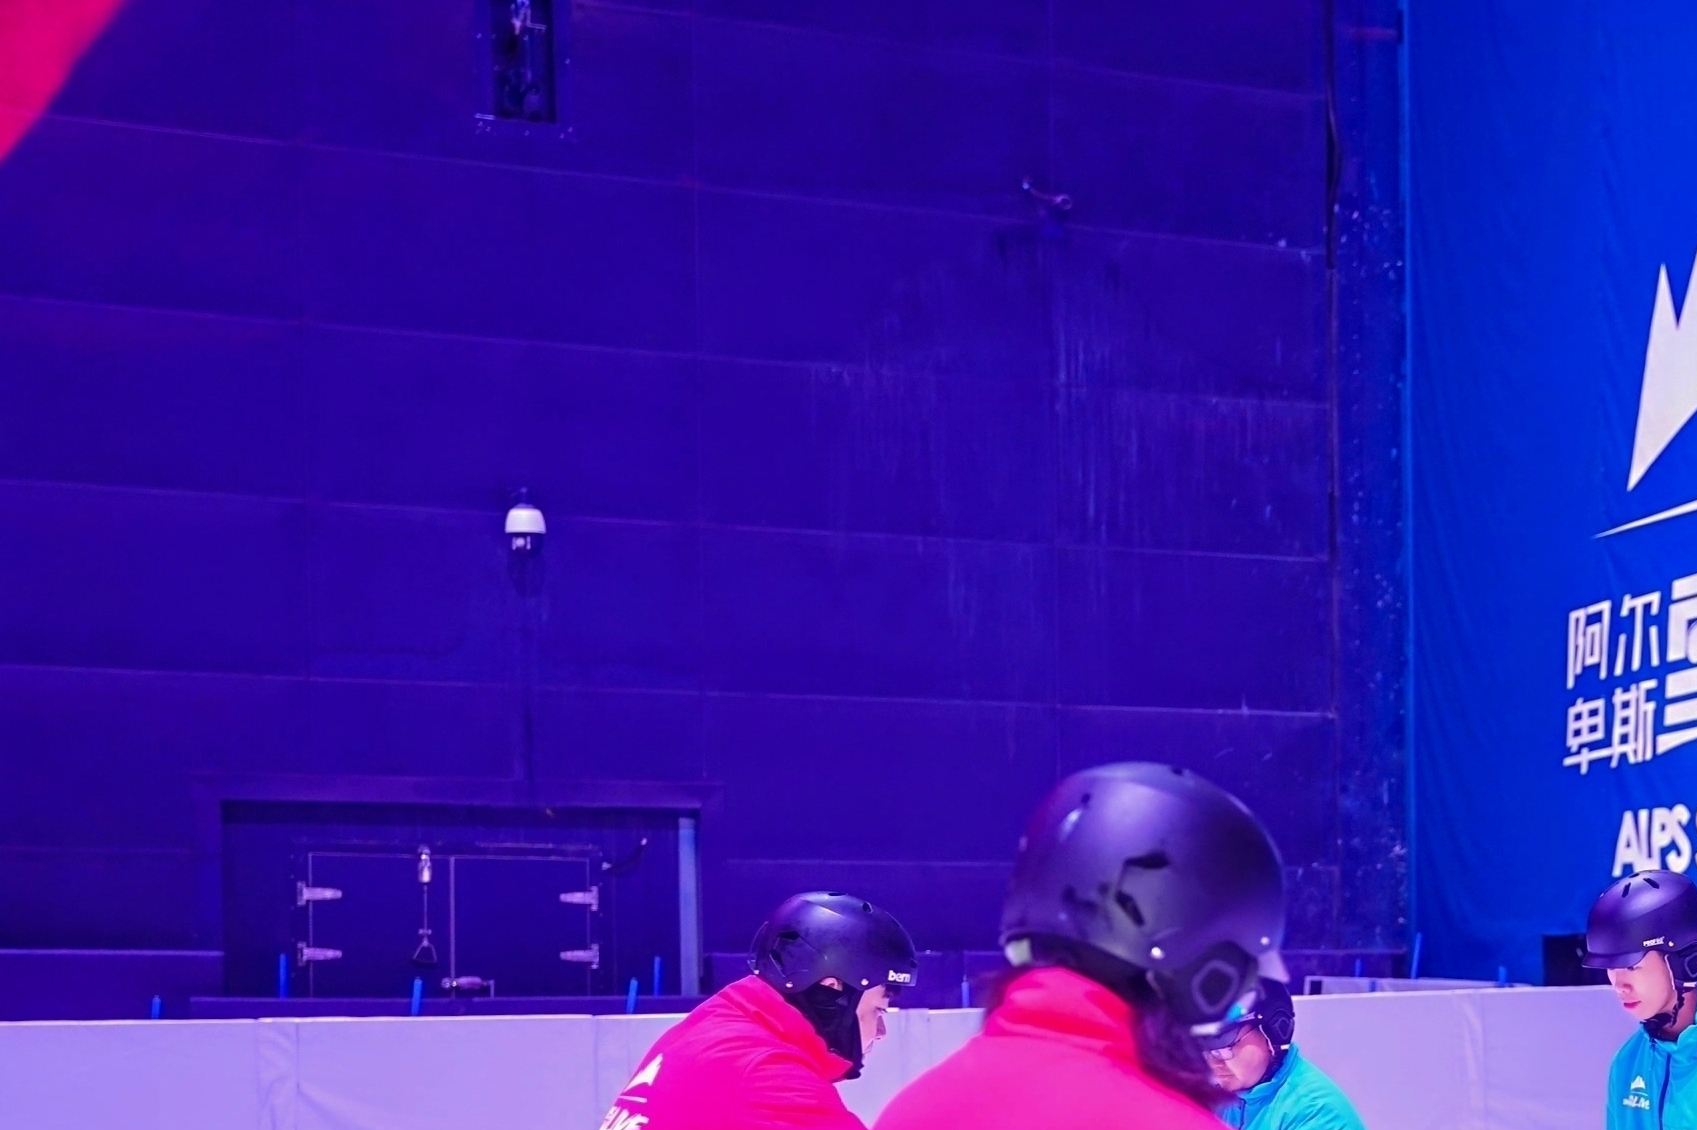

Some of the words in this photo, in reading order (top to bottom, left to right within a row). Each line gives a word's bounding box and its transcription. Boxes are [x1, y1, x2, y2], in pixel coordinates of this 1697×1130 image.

[1566, 590, 1661, 689] 阿尔
[1562, 678, 1658, 775] 卑斯
[1611, 803, 1692, 877] ALPS
